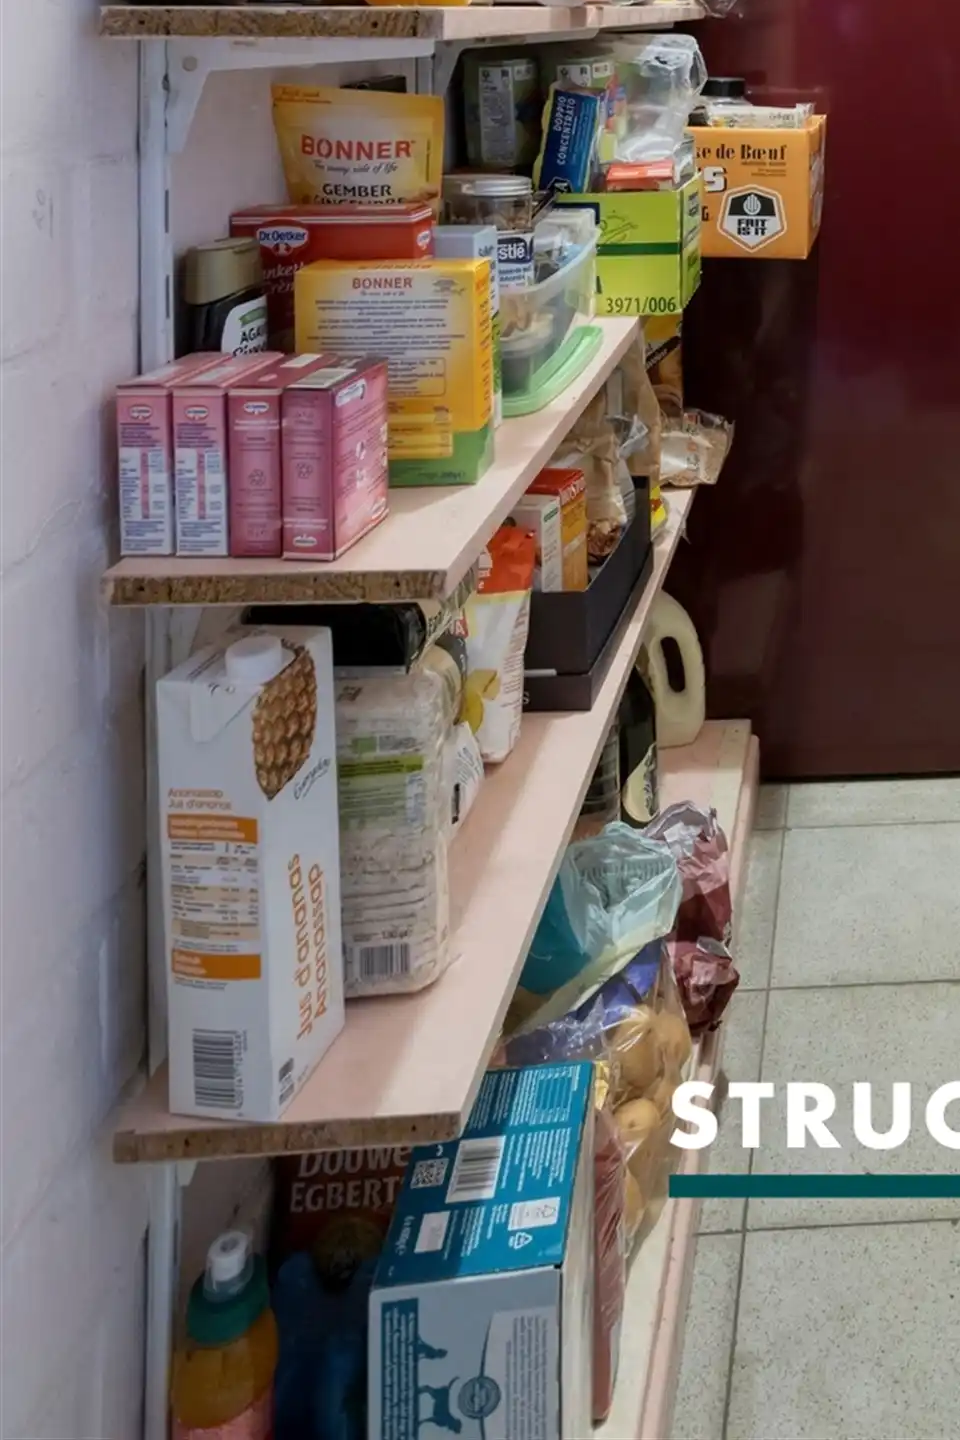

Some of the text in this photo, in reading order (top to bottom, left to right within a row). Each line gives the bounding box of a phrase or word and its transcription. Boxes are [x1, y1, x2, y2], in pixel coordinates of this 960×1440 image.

[553, 95, 567, 131] DOPPIO
[556, 98, 576, 166] CONCENTRATO
[301, 134, 412, 160] BONNER
[716, 144, 735, 160] de
[322, 182, 392, 198] GEMBER
[352, 277, 413, 290] BONNER
[606, 296, 677, 314] 3971/006
[307, 863, 328, 1018] Ananassap
